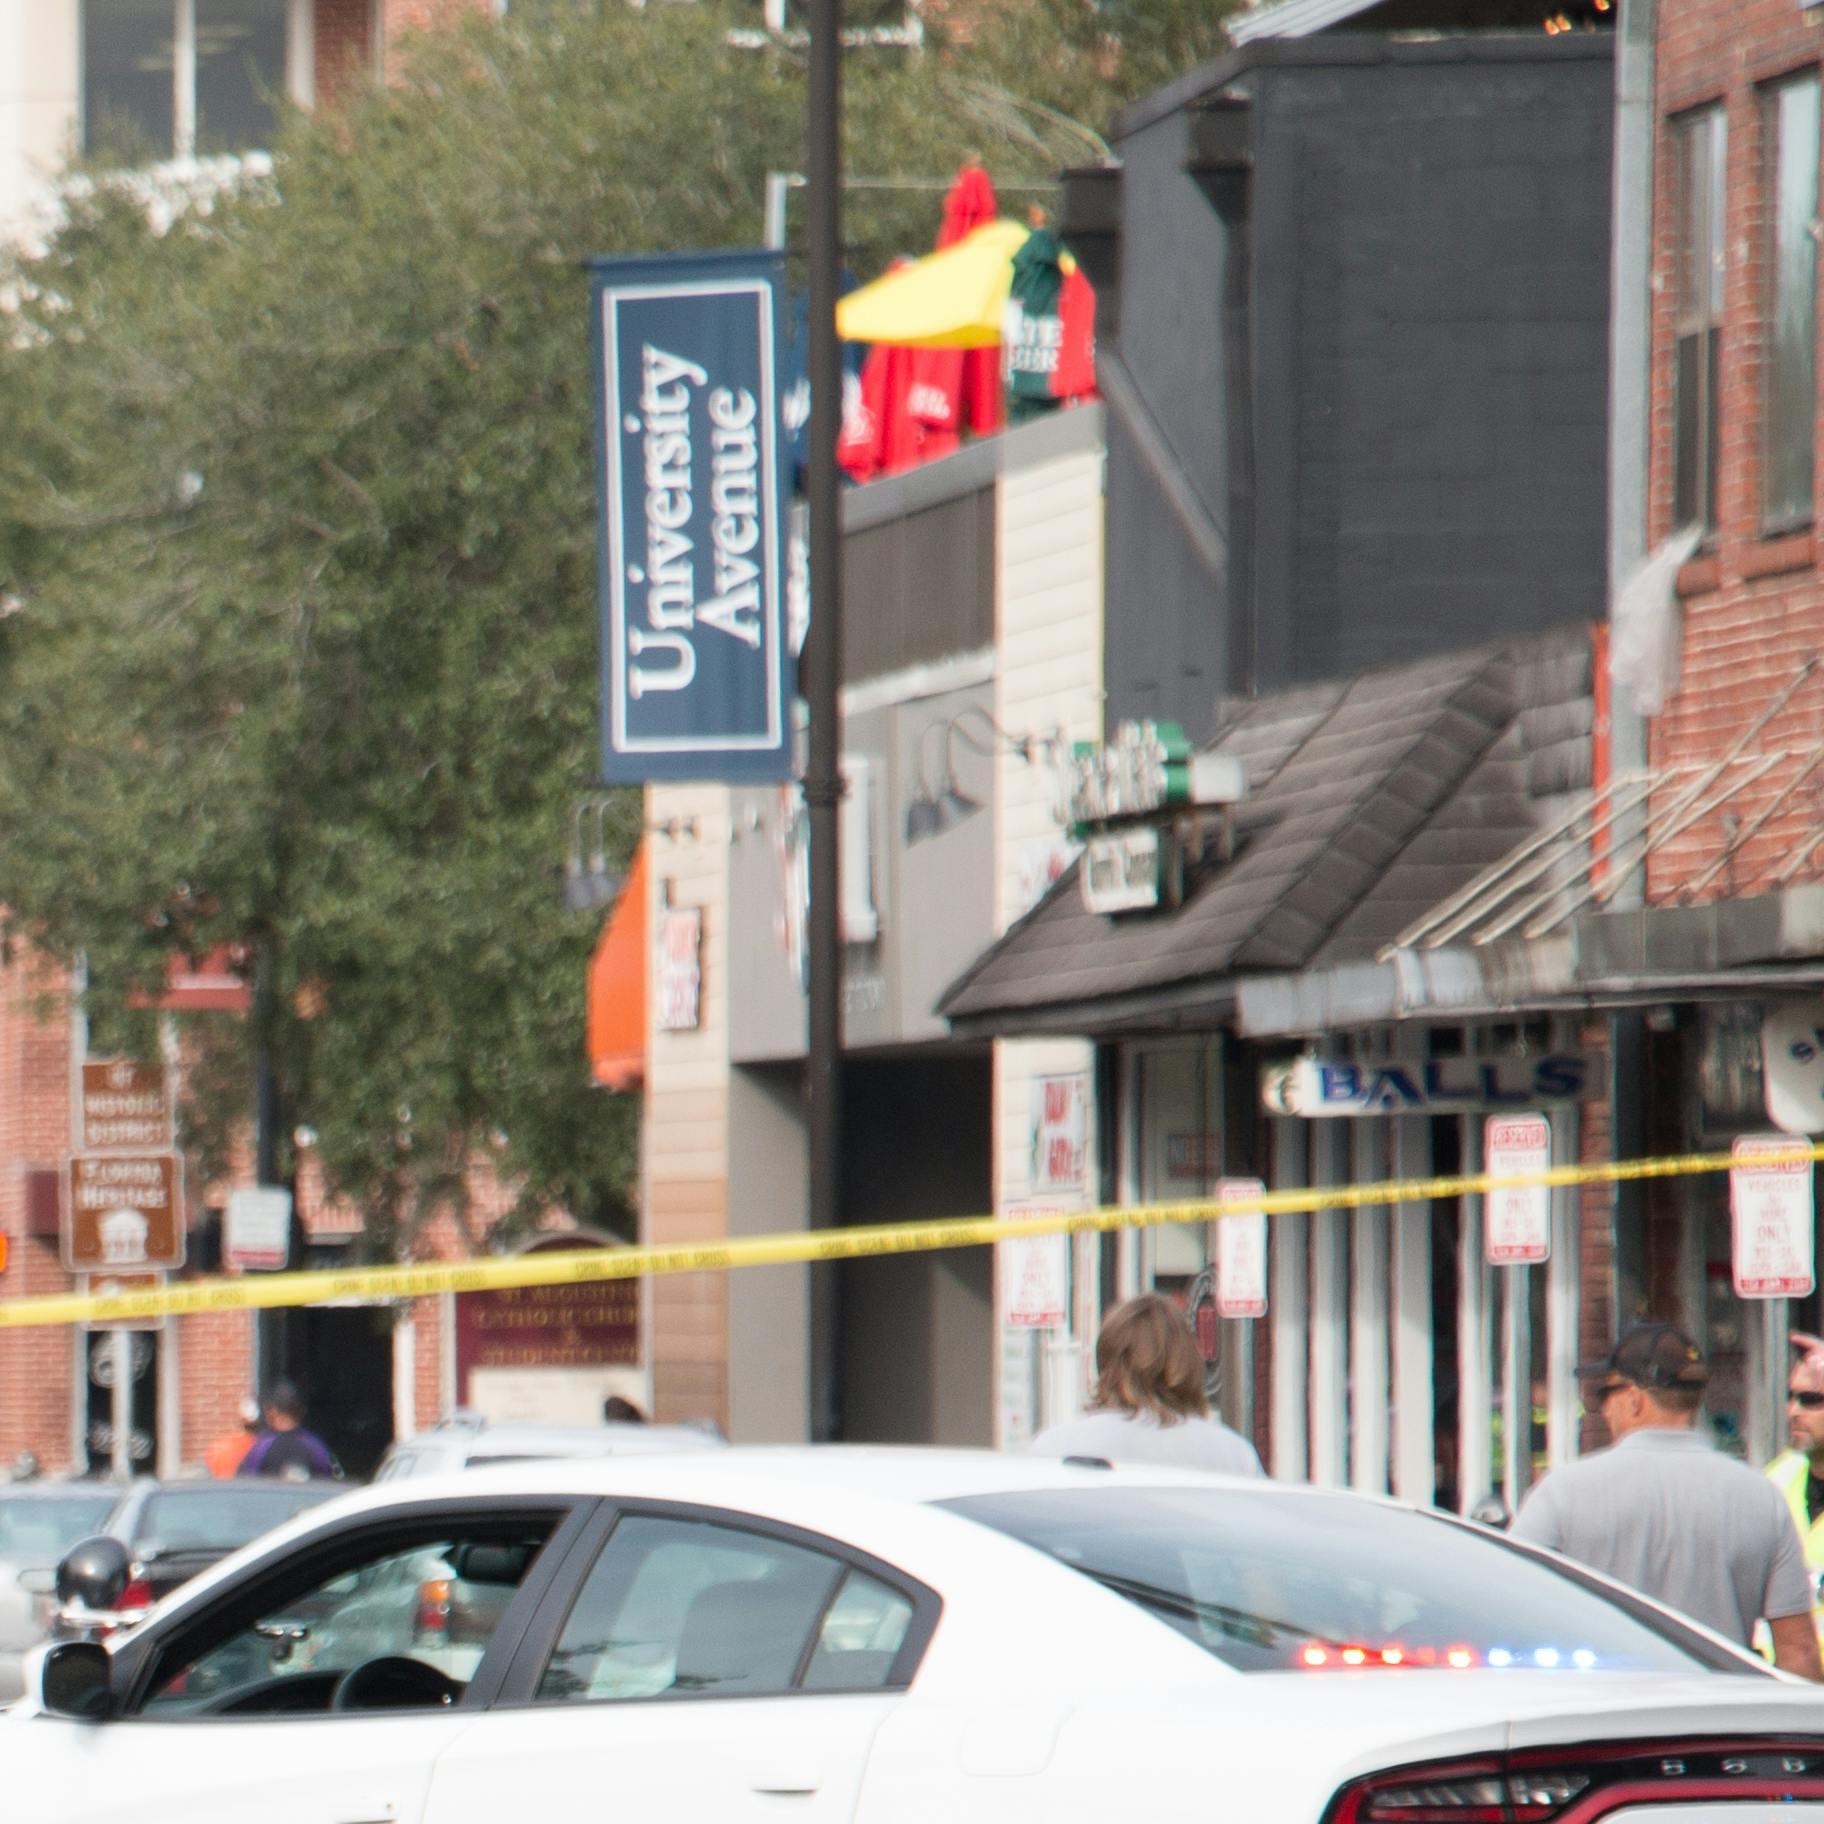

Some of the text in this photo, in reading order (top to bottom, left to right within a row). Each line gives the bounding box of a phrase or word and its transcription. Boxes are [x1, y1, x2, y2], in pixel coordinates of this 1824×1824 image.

[623, 341, 708, 700] University
[695, 385, 760, 651] Avenue
[1318, 1055, 1585, 1111] BALLS
